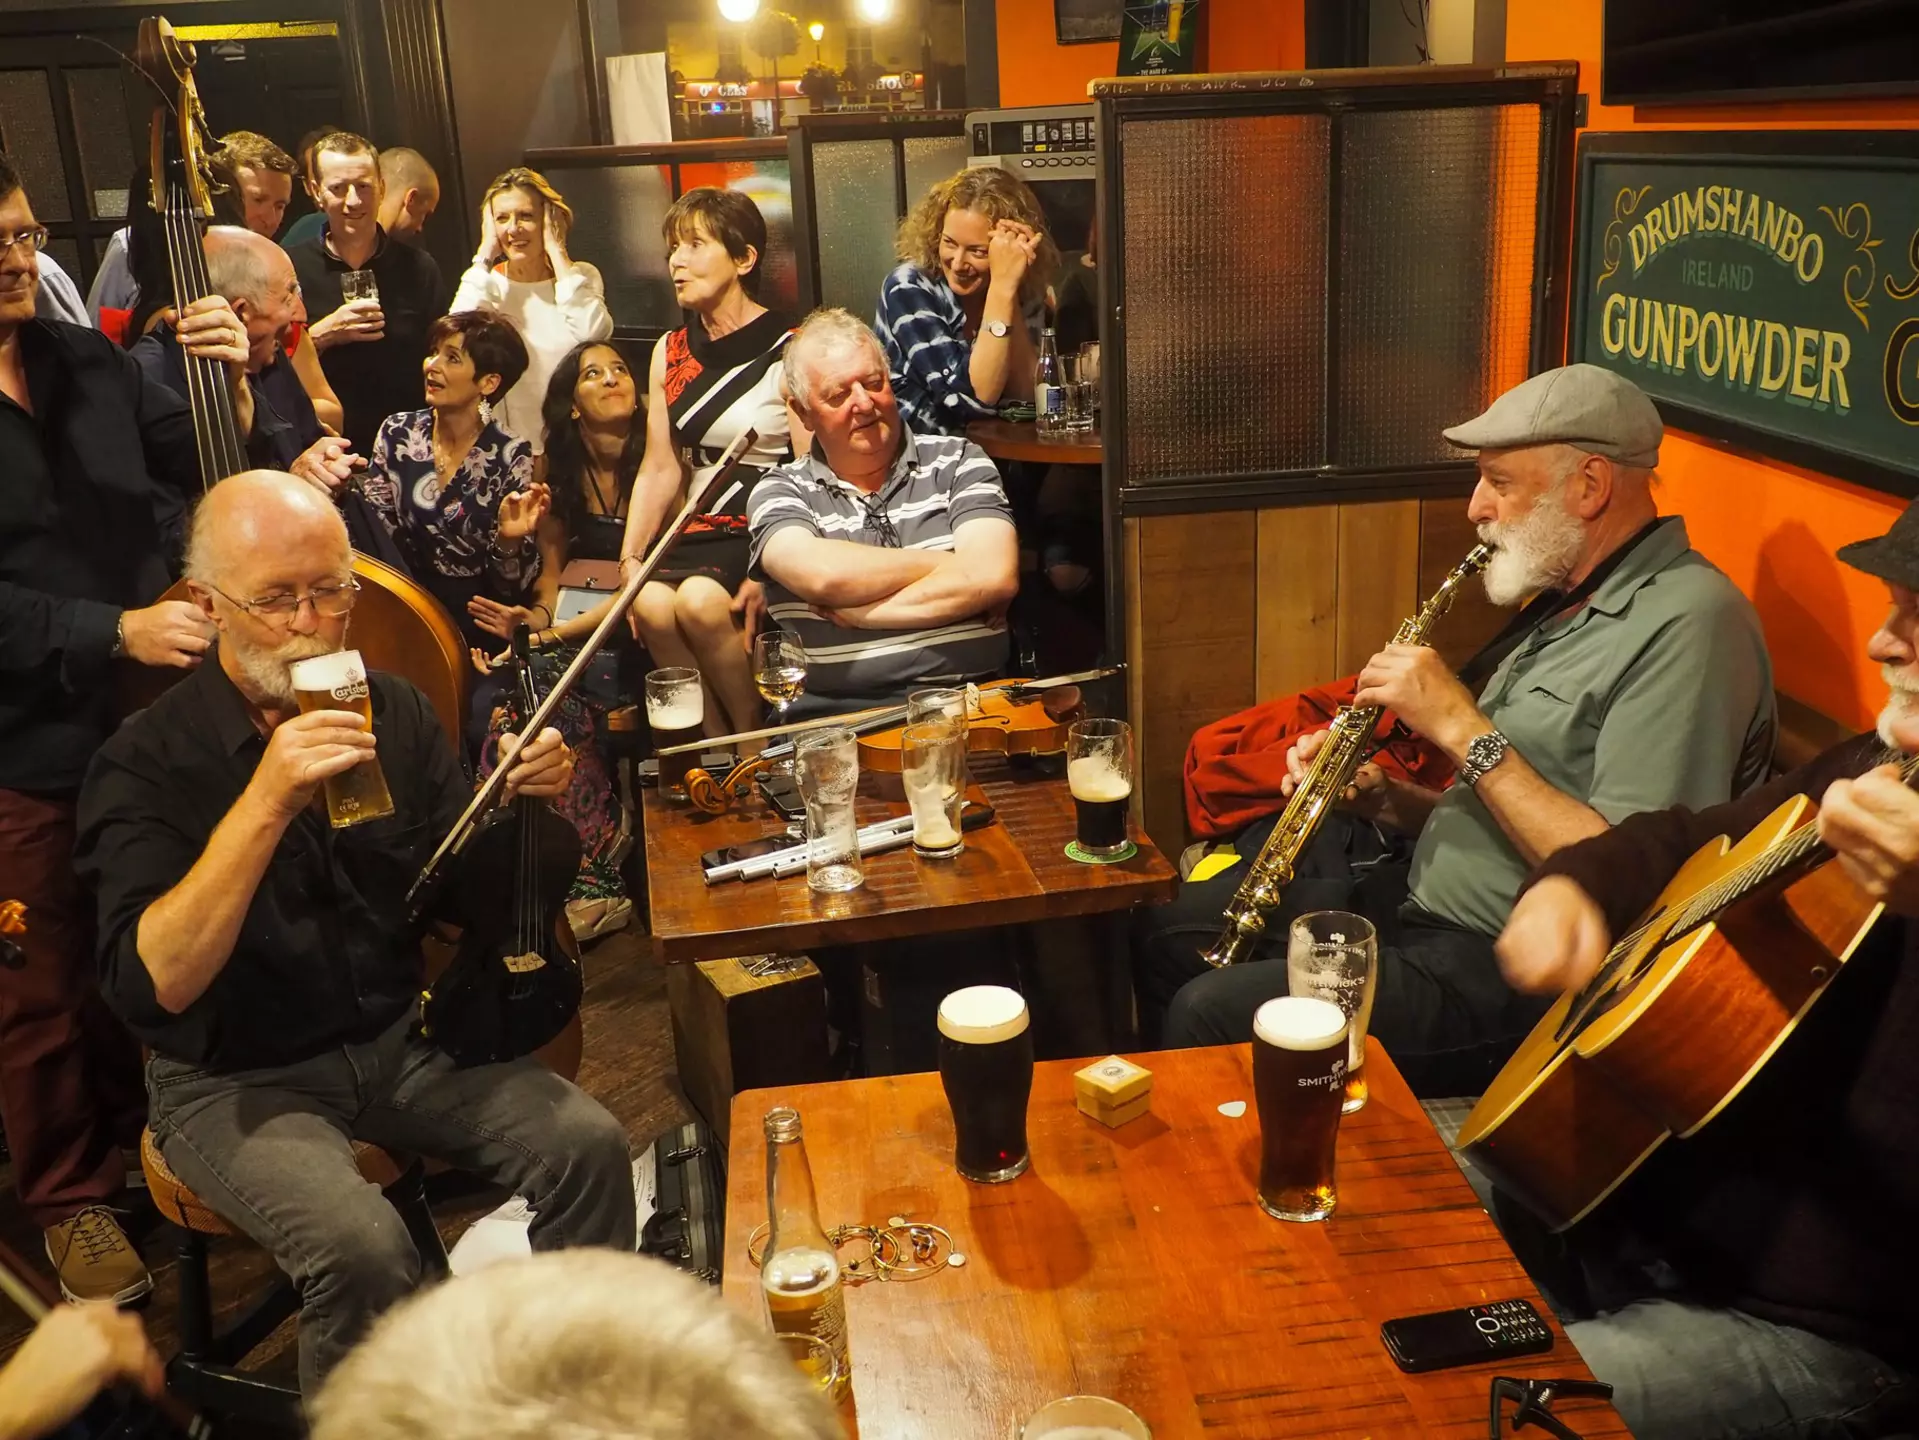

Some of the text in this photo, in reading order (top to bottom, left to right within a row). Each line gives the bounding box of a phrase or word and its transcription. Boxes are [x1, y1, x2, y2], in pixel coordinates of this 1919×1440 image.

[1627, 185, 1824, 283] DRUMSHANBO
[1681, 258, 1754, 292] IRELAND
[1602, 292, 1851, 410] GUNPOWDER
